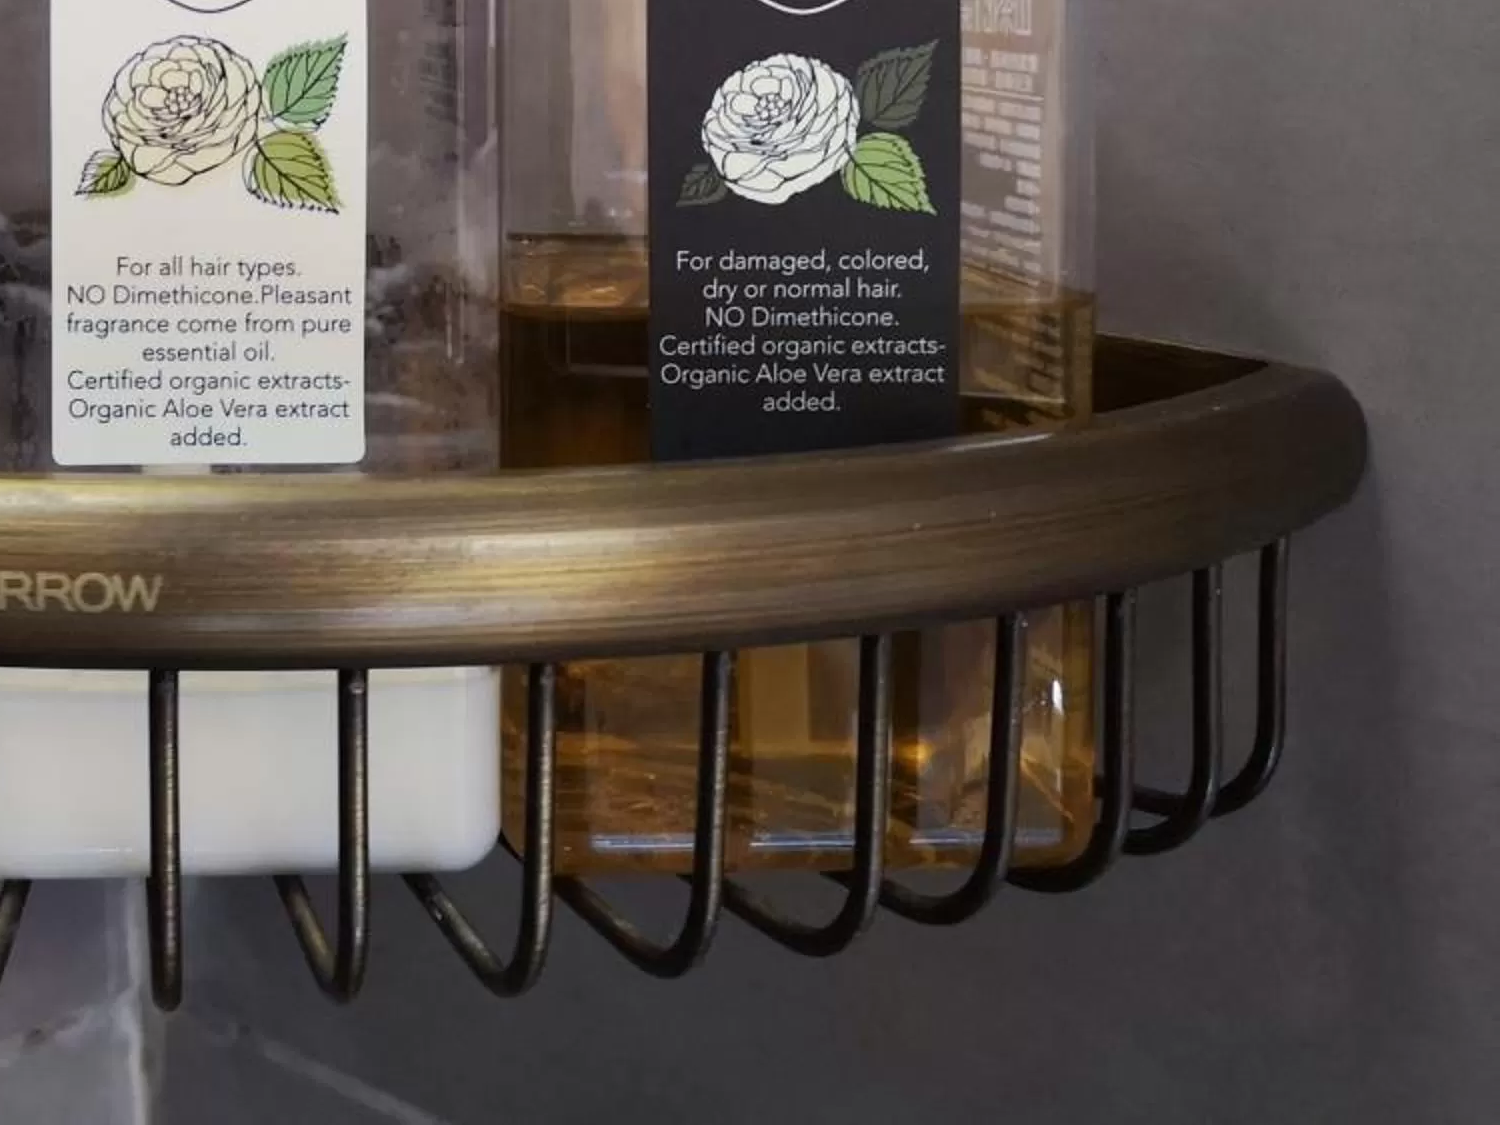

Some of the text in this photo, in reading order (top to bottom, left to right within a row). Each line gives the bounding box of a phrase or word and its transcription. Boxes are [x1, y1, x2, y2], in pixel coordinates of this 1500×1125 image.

[116, 256, 302, 281] For all hair types.
[676, 249, 929, 275] For damaged, colored,
[67, 285, 106, 305] NO
[703, 278, 902, 304] dry or normal hair.
[67, 312, 352, 338] fragrance come from pure
[705, 306, 900, 327] NO Dimethicone.
[142, 341, 275, 362] essential oil.
[659, 334, 946, 360] Certified organic extracts-
[67, 370, 351, 395] Certified organic extracts-
[660, 363, 945, 389] Organic Aloe Vera extract
[68, 398, 350, 423] Organic Aloe Vera extract
[762, 391, 841, 411] added.
[170, 426, 248, 447] added.
